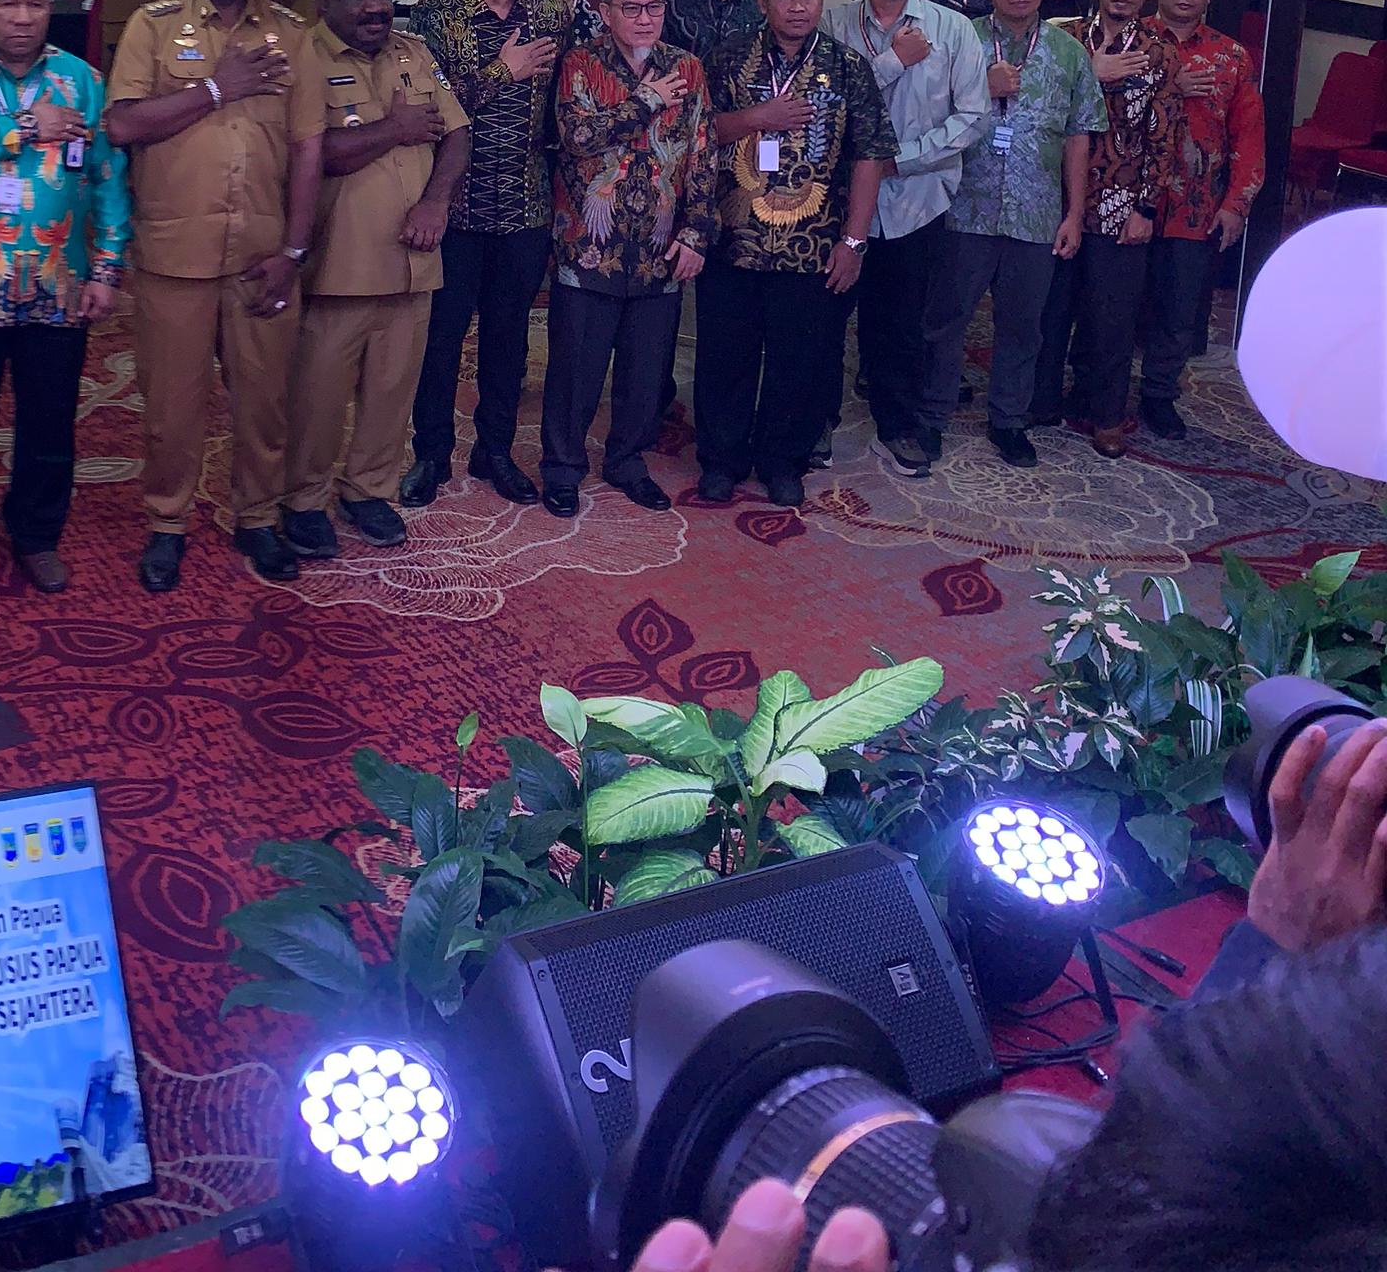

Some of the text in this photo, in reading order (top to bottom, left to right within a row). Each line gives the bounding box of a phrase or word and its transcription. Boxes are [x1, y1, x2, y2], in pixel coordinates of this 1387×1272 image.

[10, 903, 62, 933] Papua
[44, 940, 107, 970] PAPUA
[580, 1038, 631, 1093] 2
